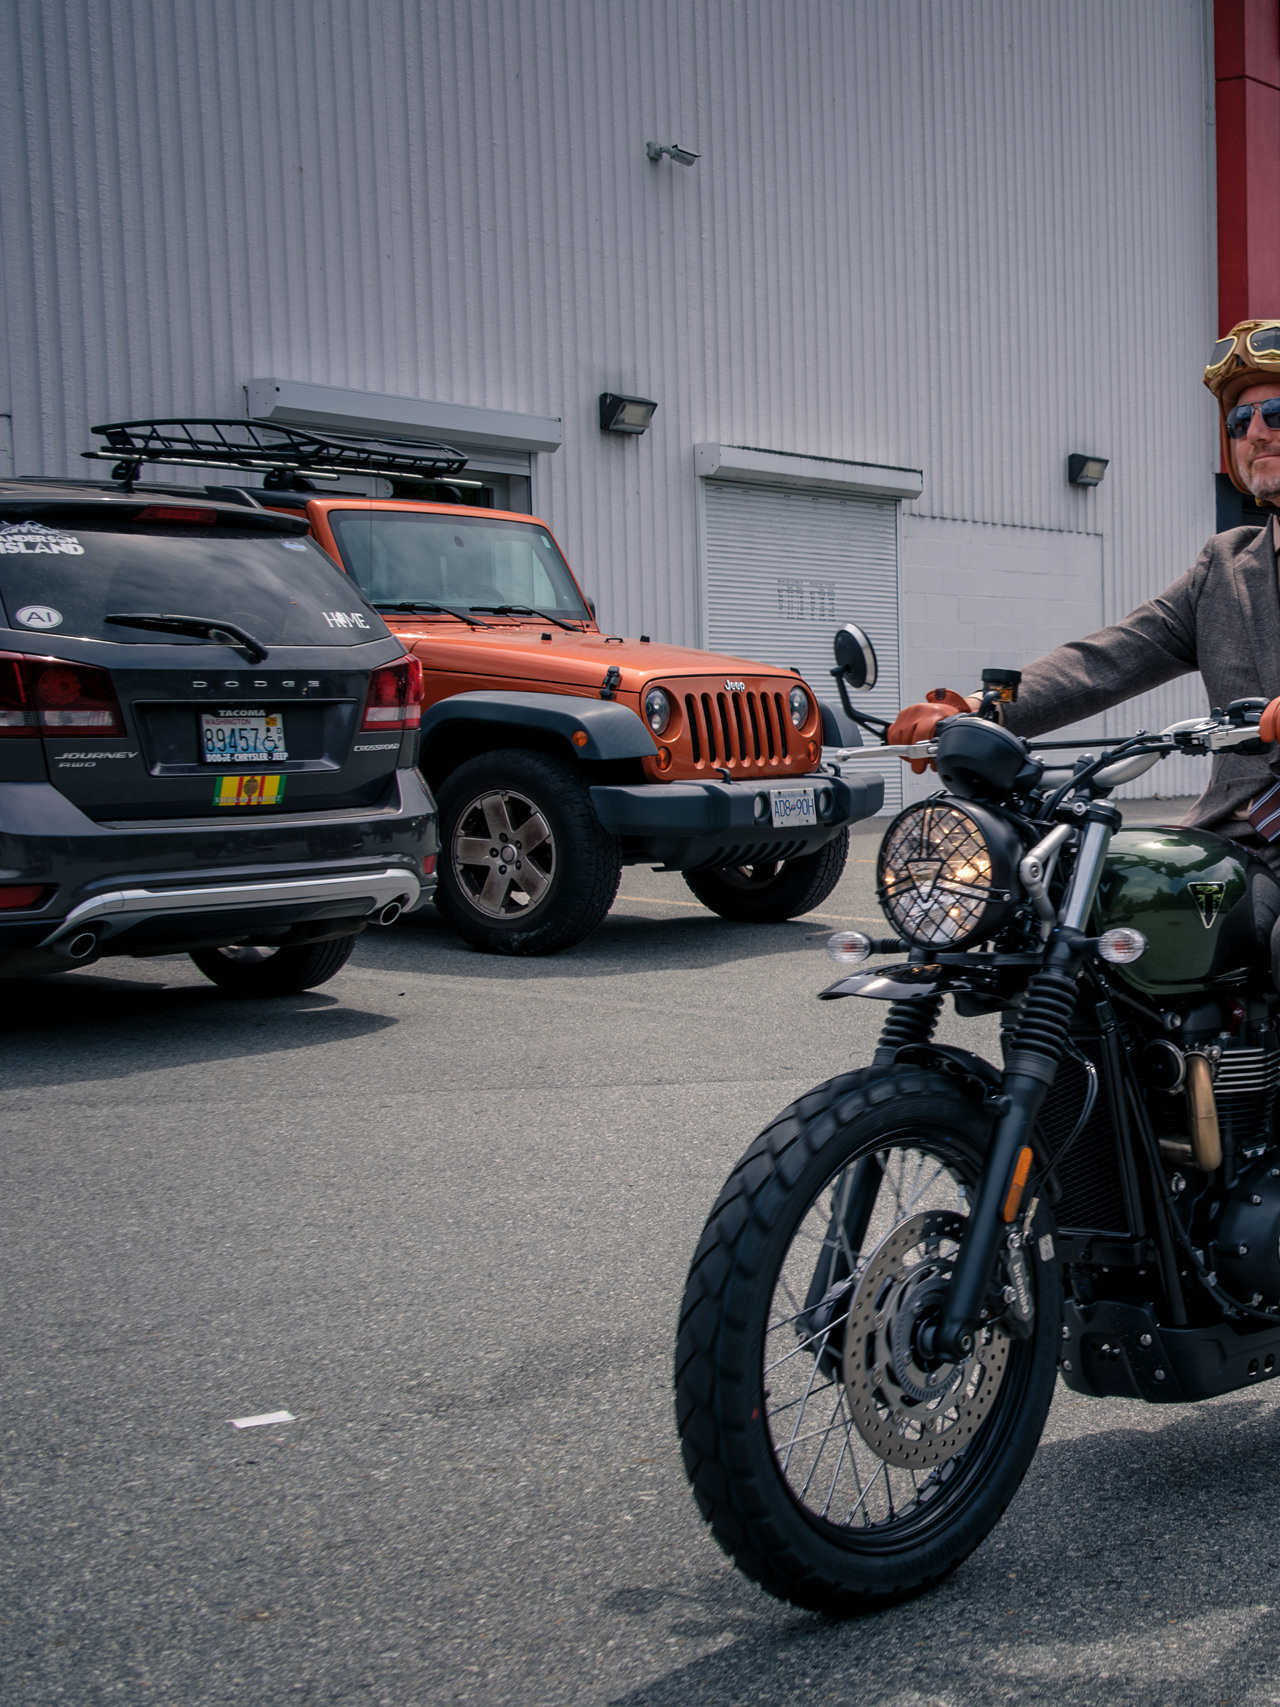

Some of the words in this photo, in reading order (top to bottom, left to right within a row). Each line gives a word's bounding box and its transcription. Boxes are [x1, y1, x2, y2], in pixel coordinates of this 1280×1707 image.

[0, 542, 85, 555] ISLAND
[26, 611, 53, 623] AI
[192, 680, 320, 688] DODGE
[725, 679, 745, 692] Jeep
[218, 709, 266, 717] TACOMA
[204, 718, 252, 726] WASHINGTON
[205, 728, 259, 753] 89457
[353, 743, 400, 752] CROSSROAD
[54, 751, 140, 760] JOURNEY
[272, 752, 289, 761] JEEP
[1013, 1261, 1030, 1314] brembo
